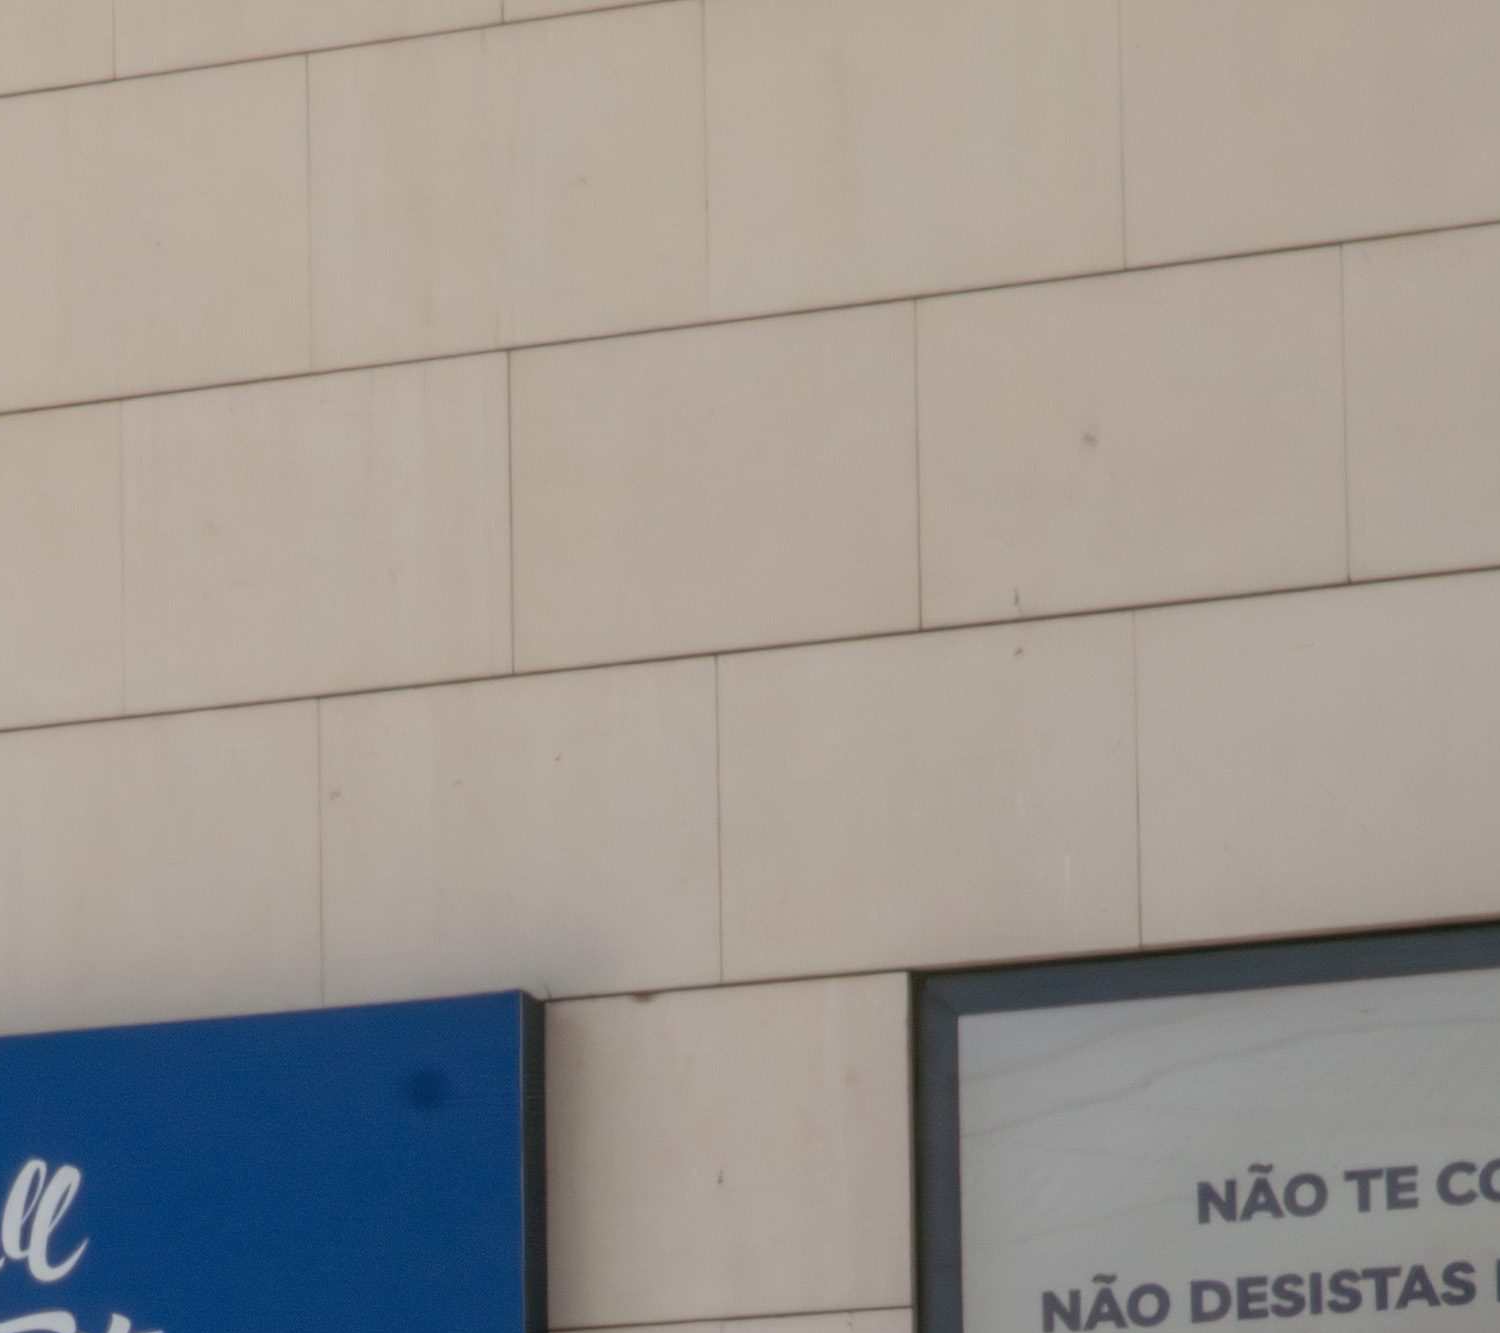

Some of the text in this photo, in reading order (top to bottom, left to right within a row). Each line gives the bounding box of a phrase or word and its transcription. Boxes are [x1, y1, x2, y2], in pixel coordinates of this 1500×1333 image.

[1196, 1162, 1330, 1225] NÃO
[1342, 1164, 1420, 1214] TE
[1189, 1259, 1478, 1325] DESISTAS
